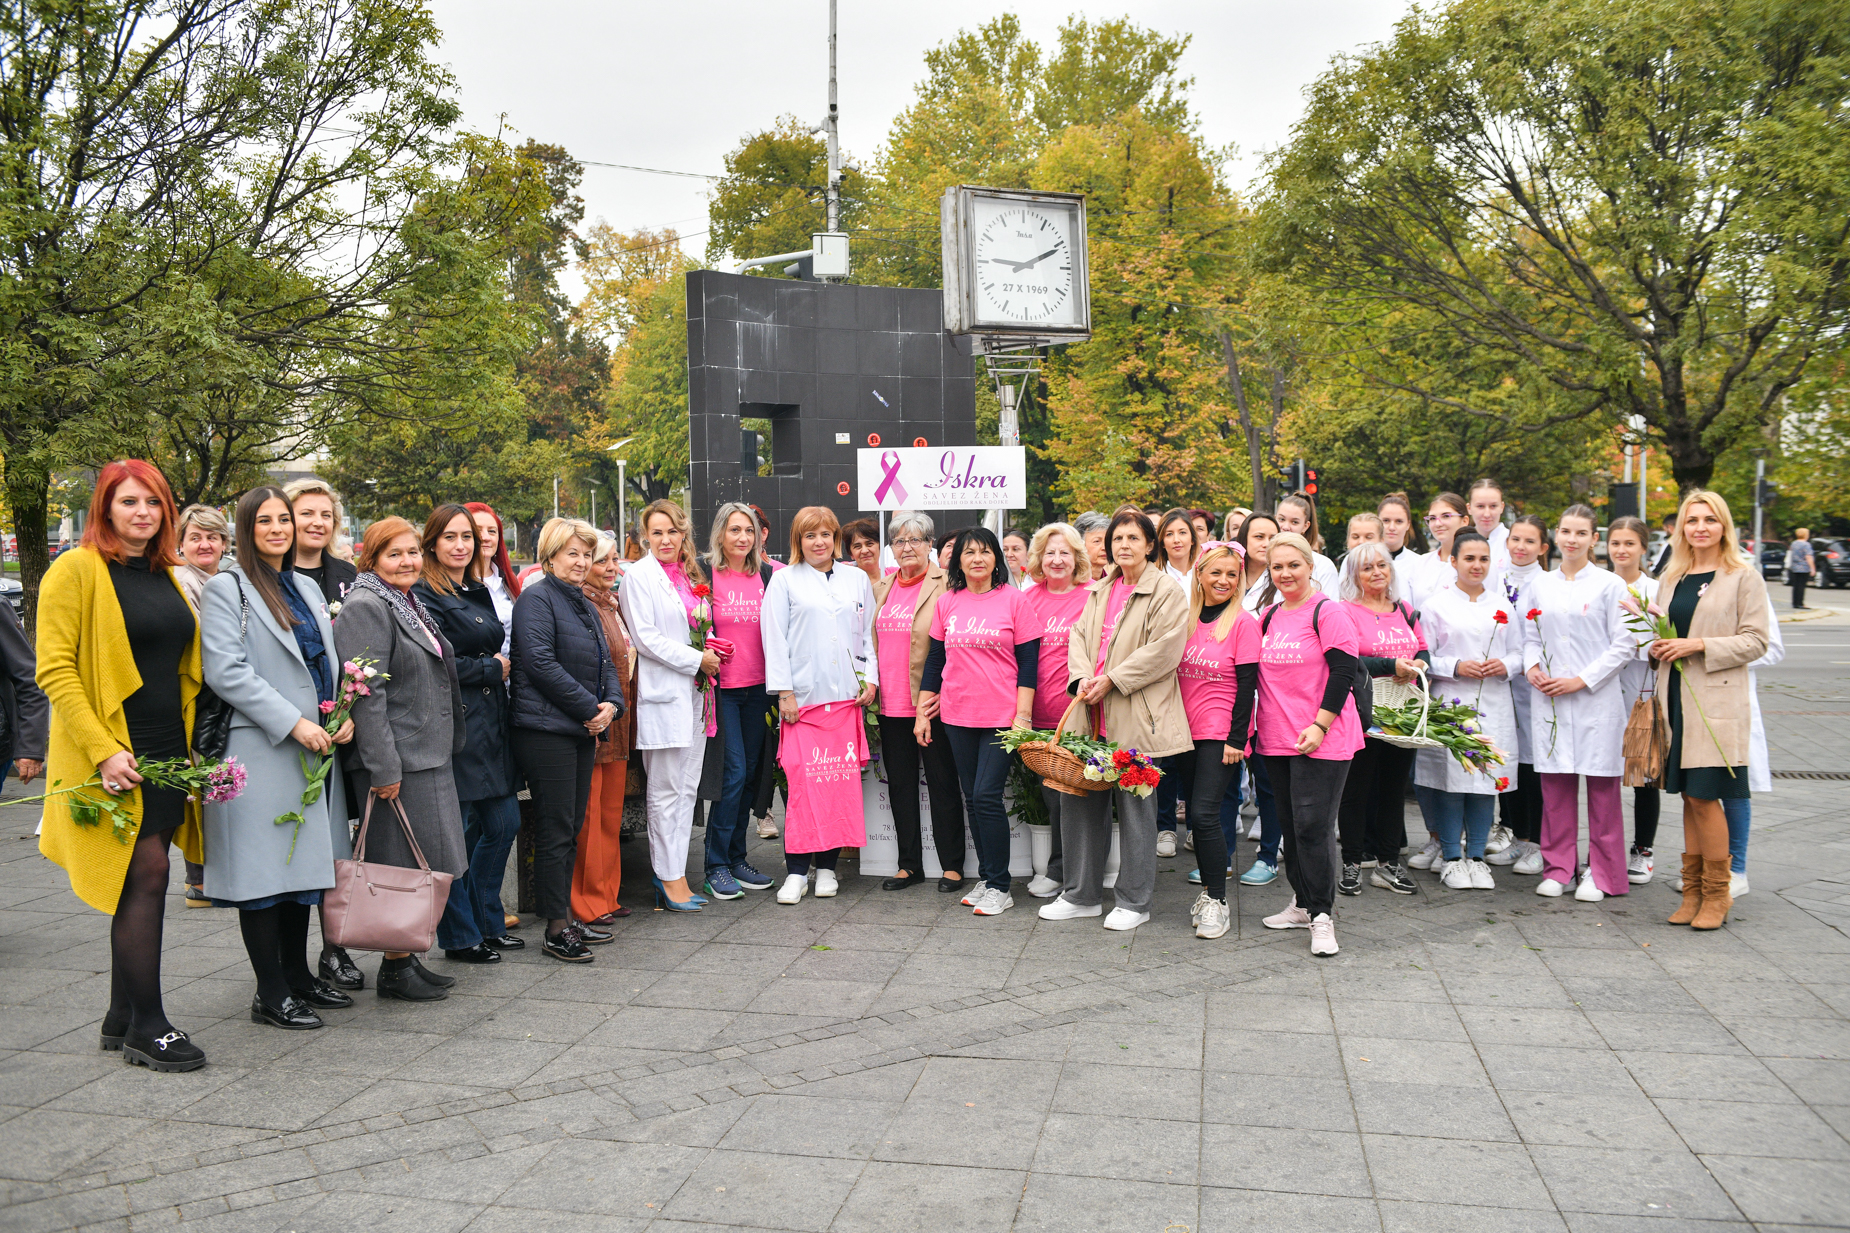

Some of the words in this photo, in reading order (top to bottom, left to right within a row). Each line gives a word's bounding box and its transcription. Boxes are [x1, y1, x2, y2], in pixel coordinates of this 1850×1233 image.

[1002, 283, 1014, 292] 27
[1016, 284, 1024, 293] X
[1026, 285, 1048, 294] 1969
[923, 450, 1008, 488] Iskra
[974, 490, 1008, 499] ŽENA
[722, 590, 758, 606] Iskra
[882, 604, 914, 620] Iskr
[956, 616, 1000, 636] Iskra
[1044, 616, 1070, 634] Iskr
[976, 638, 1000, 646] ŽENA
[1265, 632, 1301, 650] Iskra
[1372, 630, 1410, 646] Iskra
[1182, 644, 1220, 668] Iskra
[1195, 668, 1222, 678] ŽENA
[806, 746, 842, 766] Iskra
[816, 774, 850, 783] AVON
